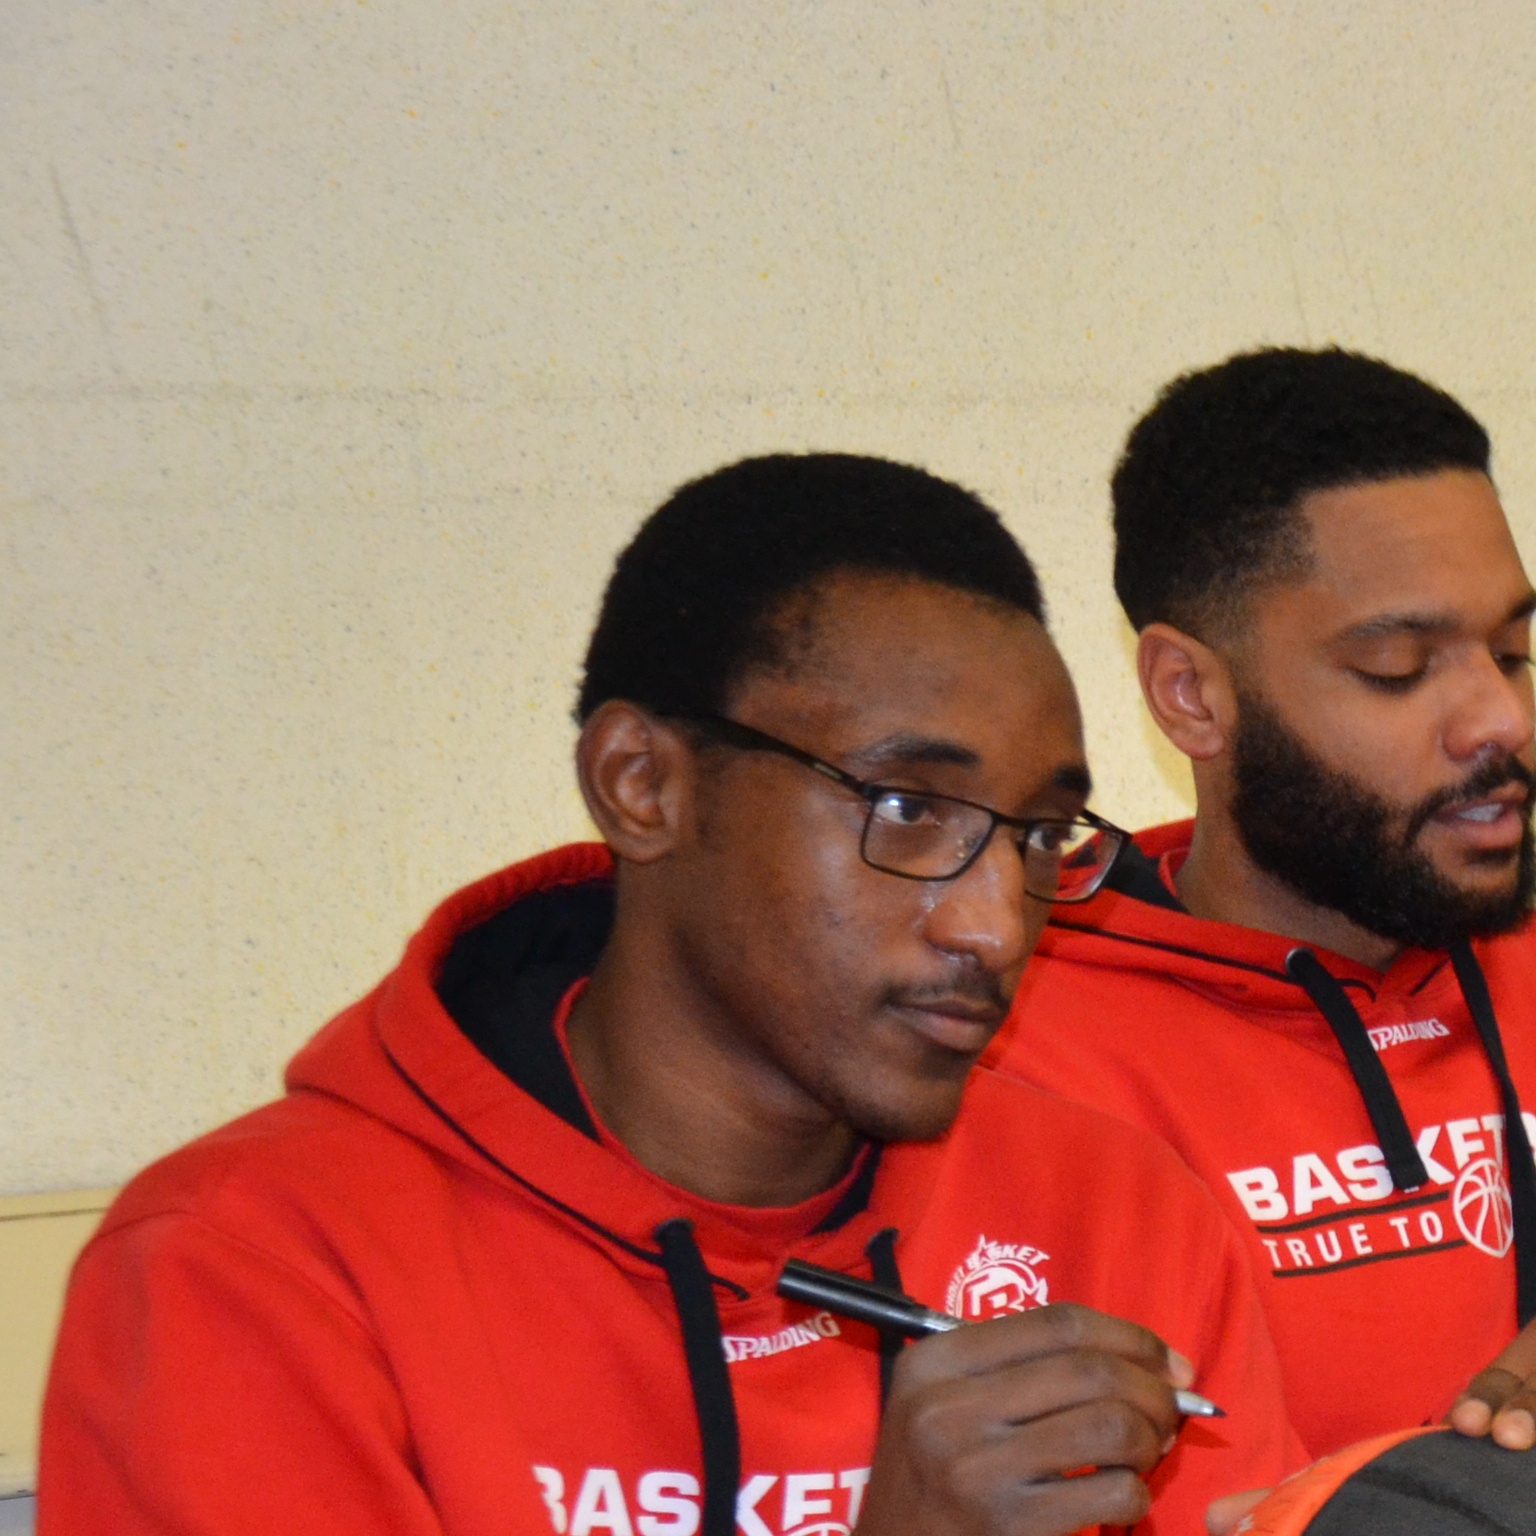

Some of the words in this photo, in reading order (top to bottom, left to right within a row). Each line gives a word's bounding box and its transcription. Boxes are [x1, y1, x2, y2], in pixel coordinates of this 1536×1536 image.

[1367, 1016, 1451, 1053] SPALDING
[1263, 1223, 1374, 1270] TRUE
[1389, 1210, 1444, 1249] TO
[722, 1312, 842, 1363] SPALDING
